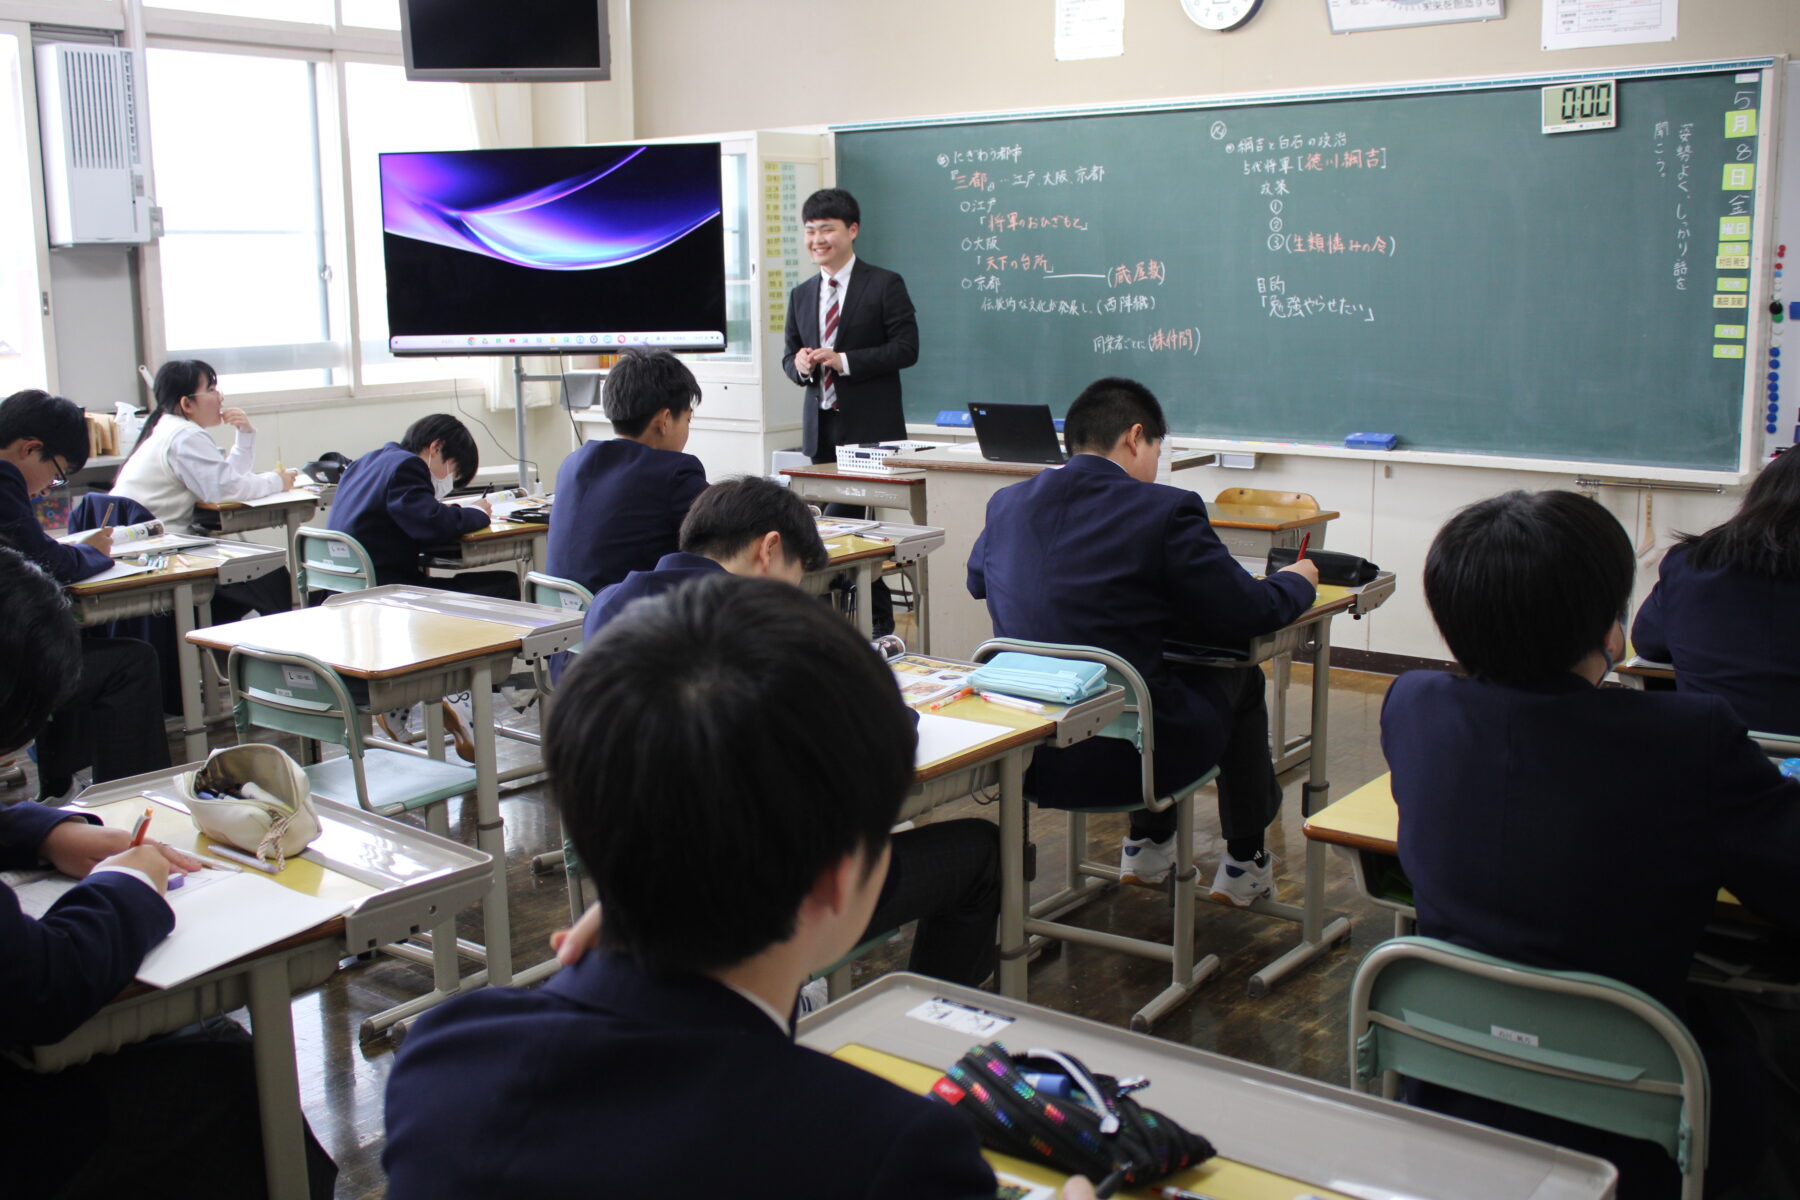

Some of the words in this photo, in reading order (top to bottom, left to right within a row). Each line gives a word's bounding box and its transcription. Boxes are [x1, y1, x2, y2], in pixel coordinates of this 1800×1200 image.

[1562, 83, 1611, 120] 0:00
[953, 144, 1023, 164] にぎわう都市
[1260, 178, 1290, 196] 政策
[1257, 274, 1286, 296] 目的
